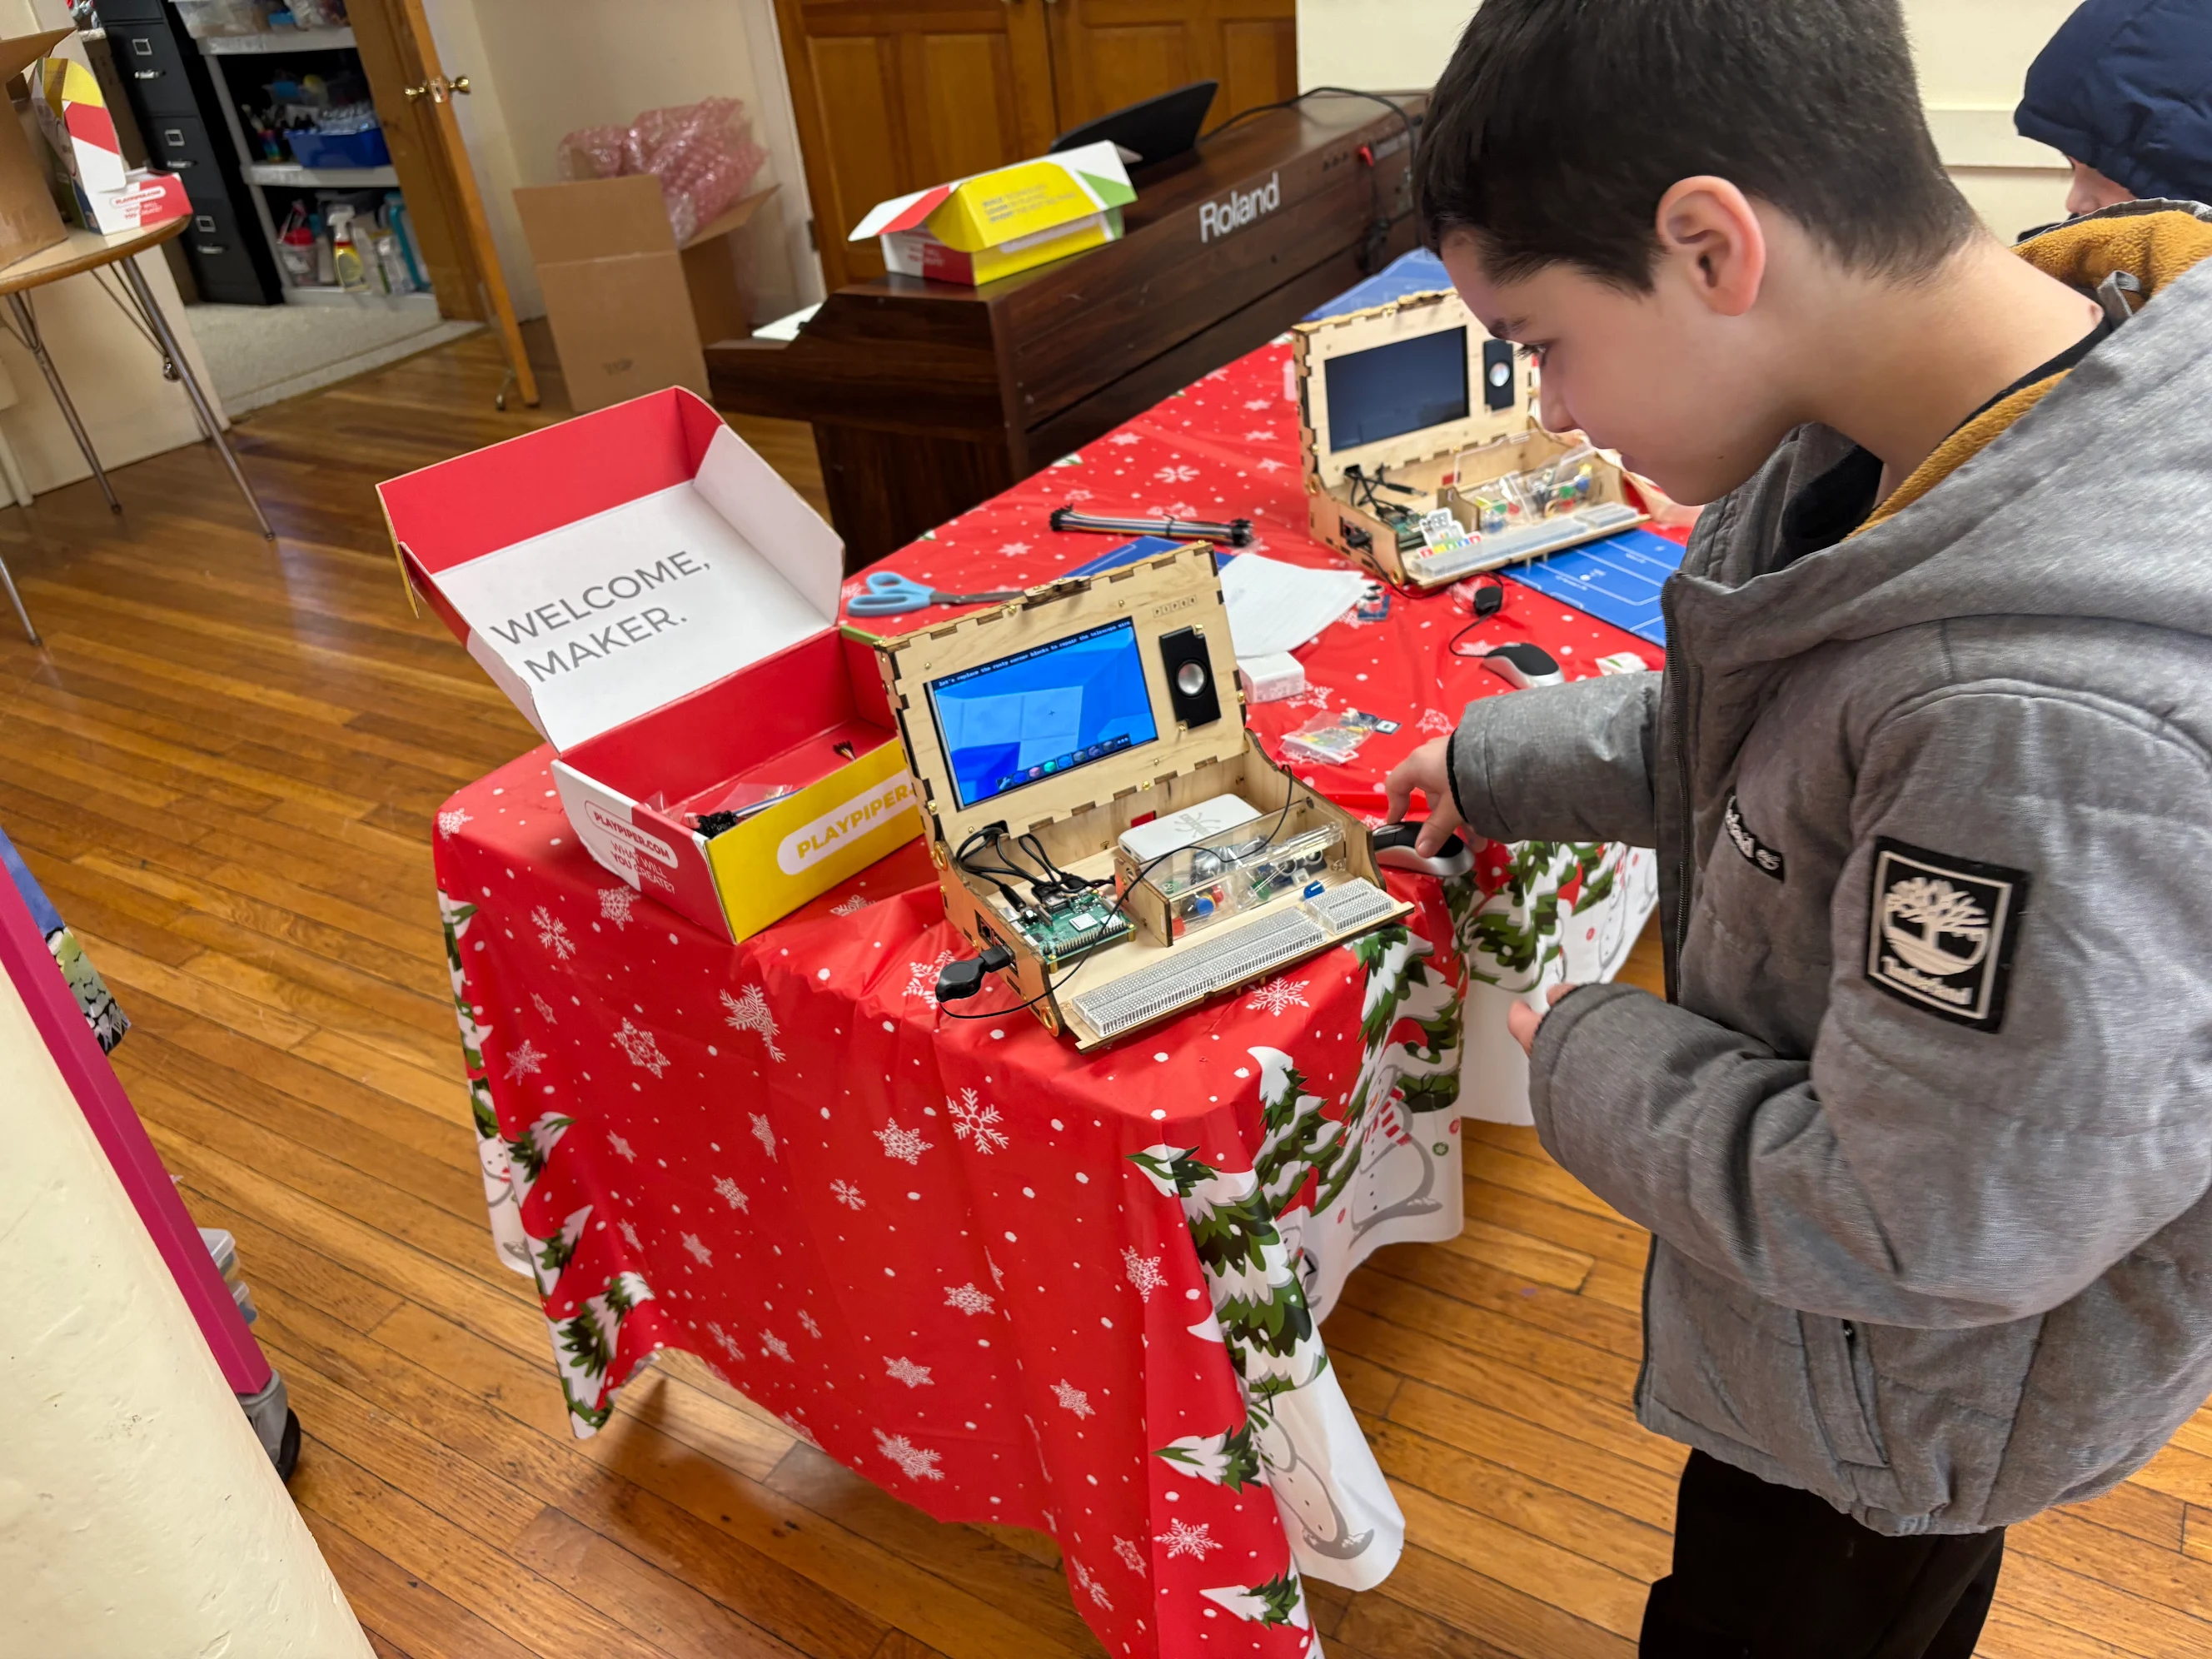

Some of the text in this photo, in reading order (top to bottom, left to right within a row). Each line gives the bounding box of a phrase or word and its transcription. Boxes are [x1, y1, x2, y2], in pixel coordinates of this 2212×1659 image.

[1199, 171, 1280, 243] Roland
[490, 551, 710, 645] WELCOME,
[524, 606, 687, 682] MAKER.
[593, 810, 670, 860] PLAYPIPER.COM
[610, 839, 667, 879] WHAT WILL
[610, 850, 675, 894] YOU CREATE?
